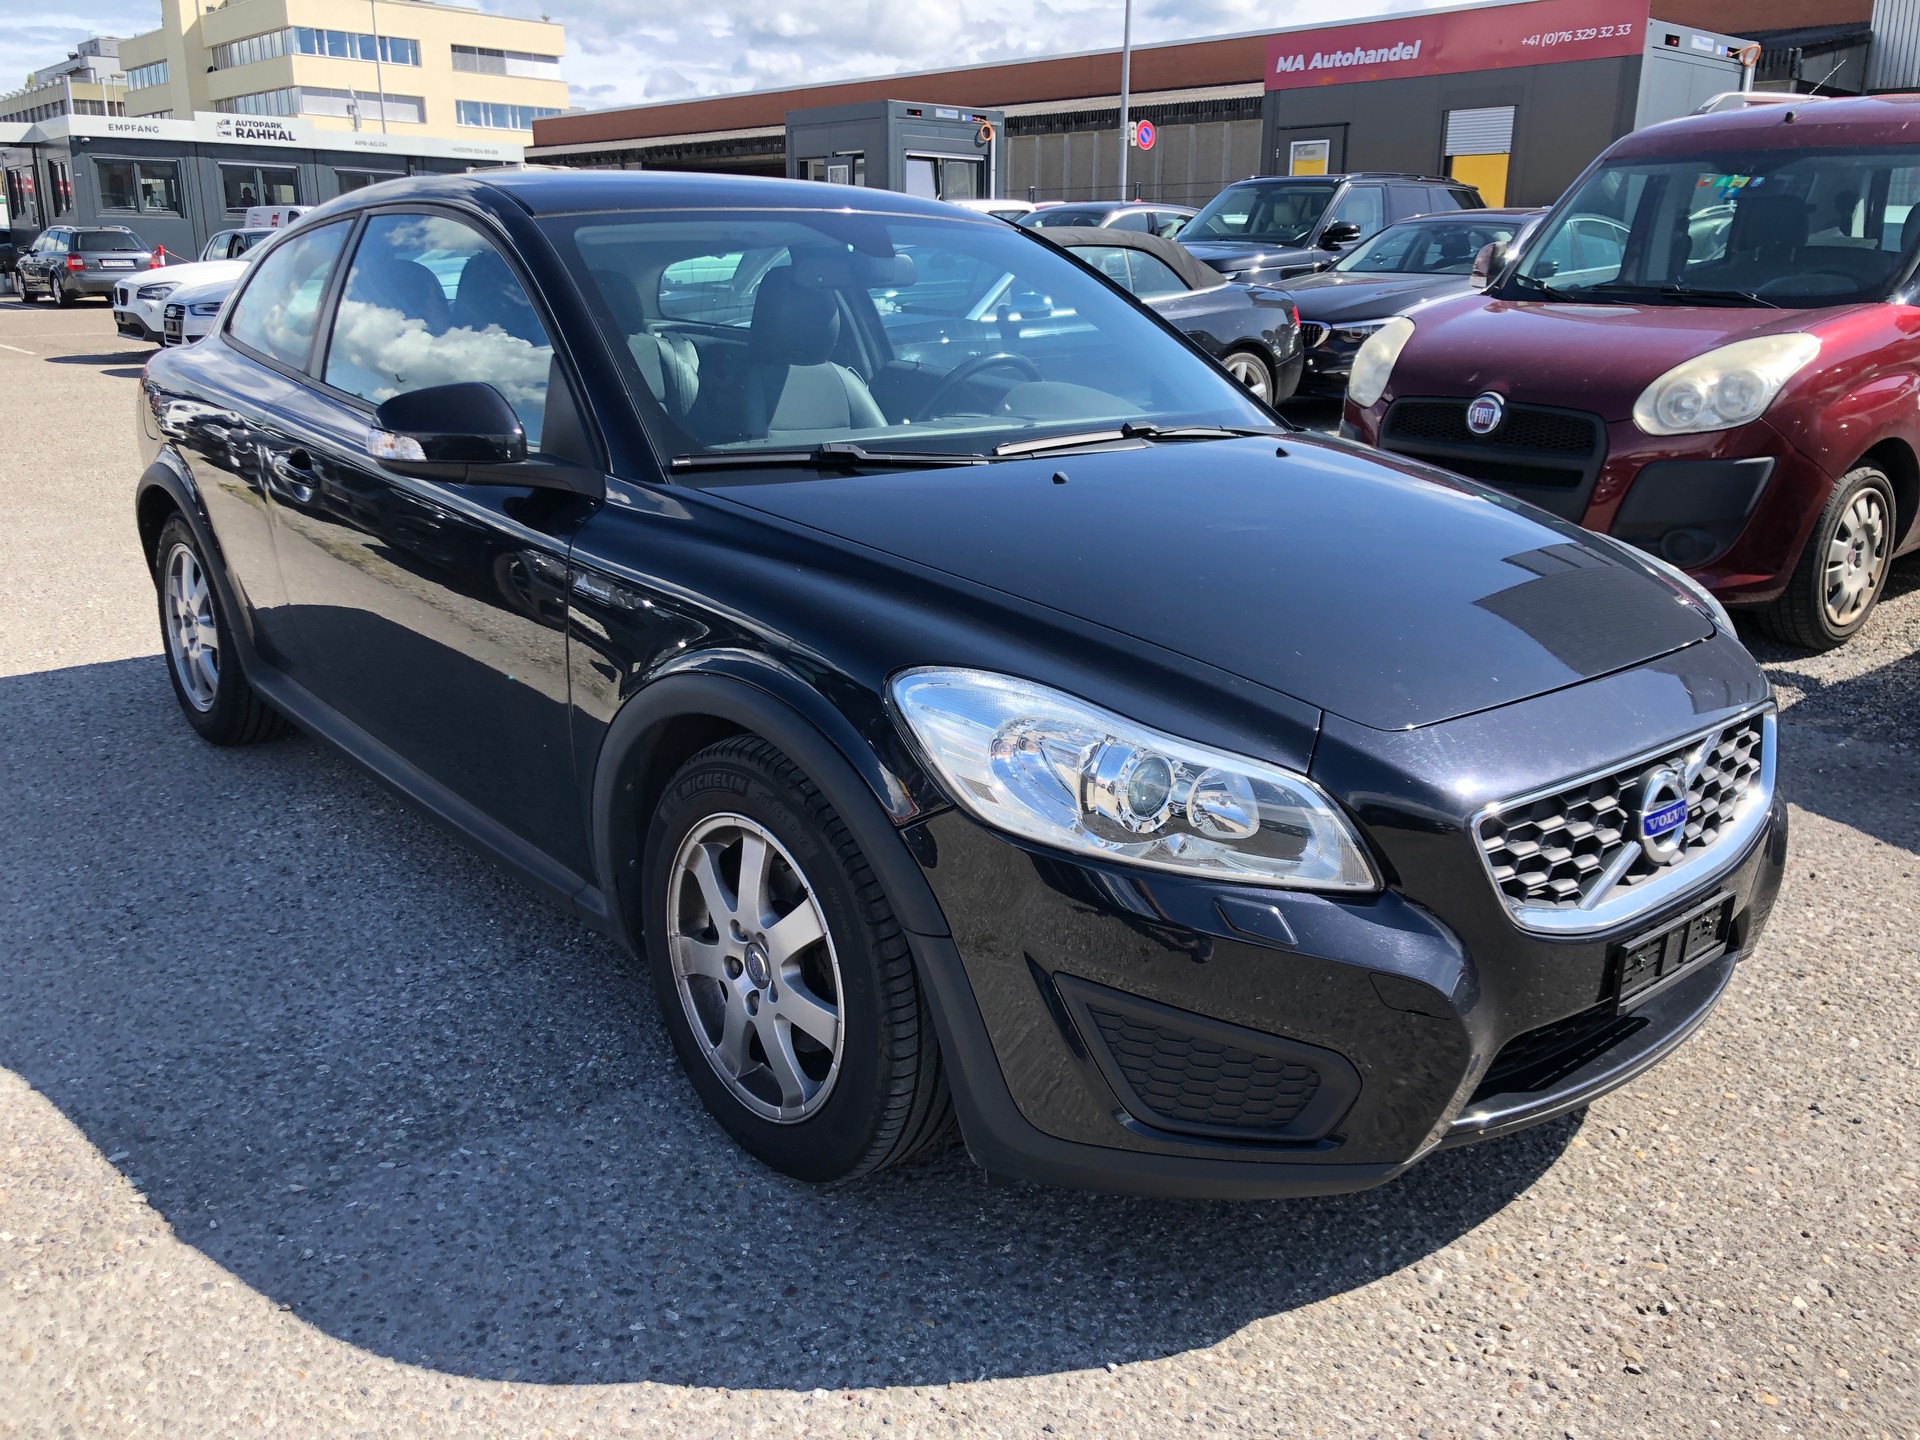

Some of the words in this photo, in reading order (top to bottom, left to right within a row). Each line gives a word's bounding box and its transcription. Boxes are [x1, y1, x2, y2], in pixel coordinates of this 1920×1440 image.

[1521, 35, 1541, 46] +41
[1542, 31, 1573, 47] (0)76
[1574, 28, 1597, 40] 329
[1598, 25, 1614, 38] 32
[1615, 24, 1632, 36] 33
[1276, 55, 1305, 73] MA
[1308, 40, 1422, 70] Autohandel
[108, 124, 159, 133] EMPFANG
[235, 120, 283, 129] AUTOPARK
[235, 128, 297, 142] RAHHAL
[1474, 407, 1494, 424] FIAT
[681, 773, 746, 798] MICHELIN
[756, 792, 788, 824] 205/55
[1647, 805, 1686, 830] VOLVO
